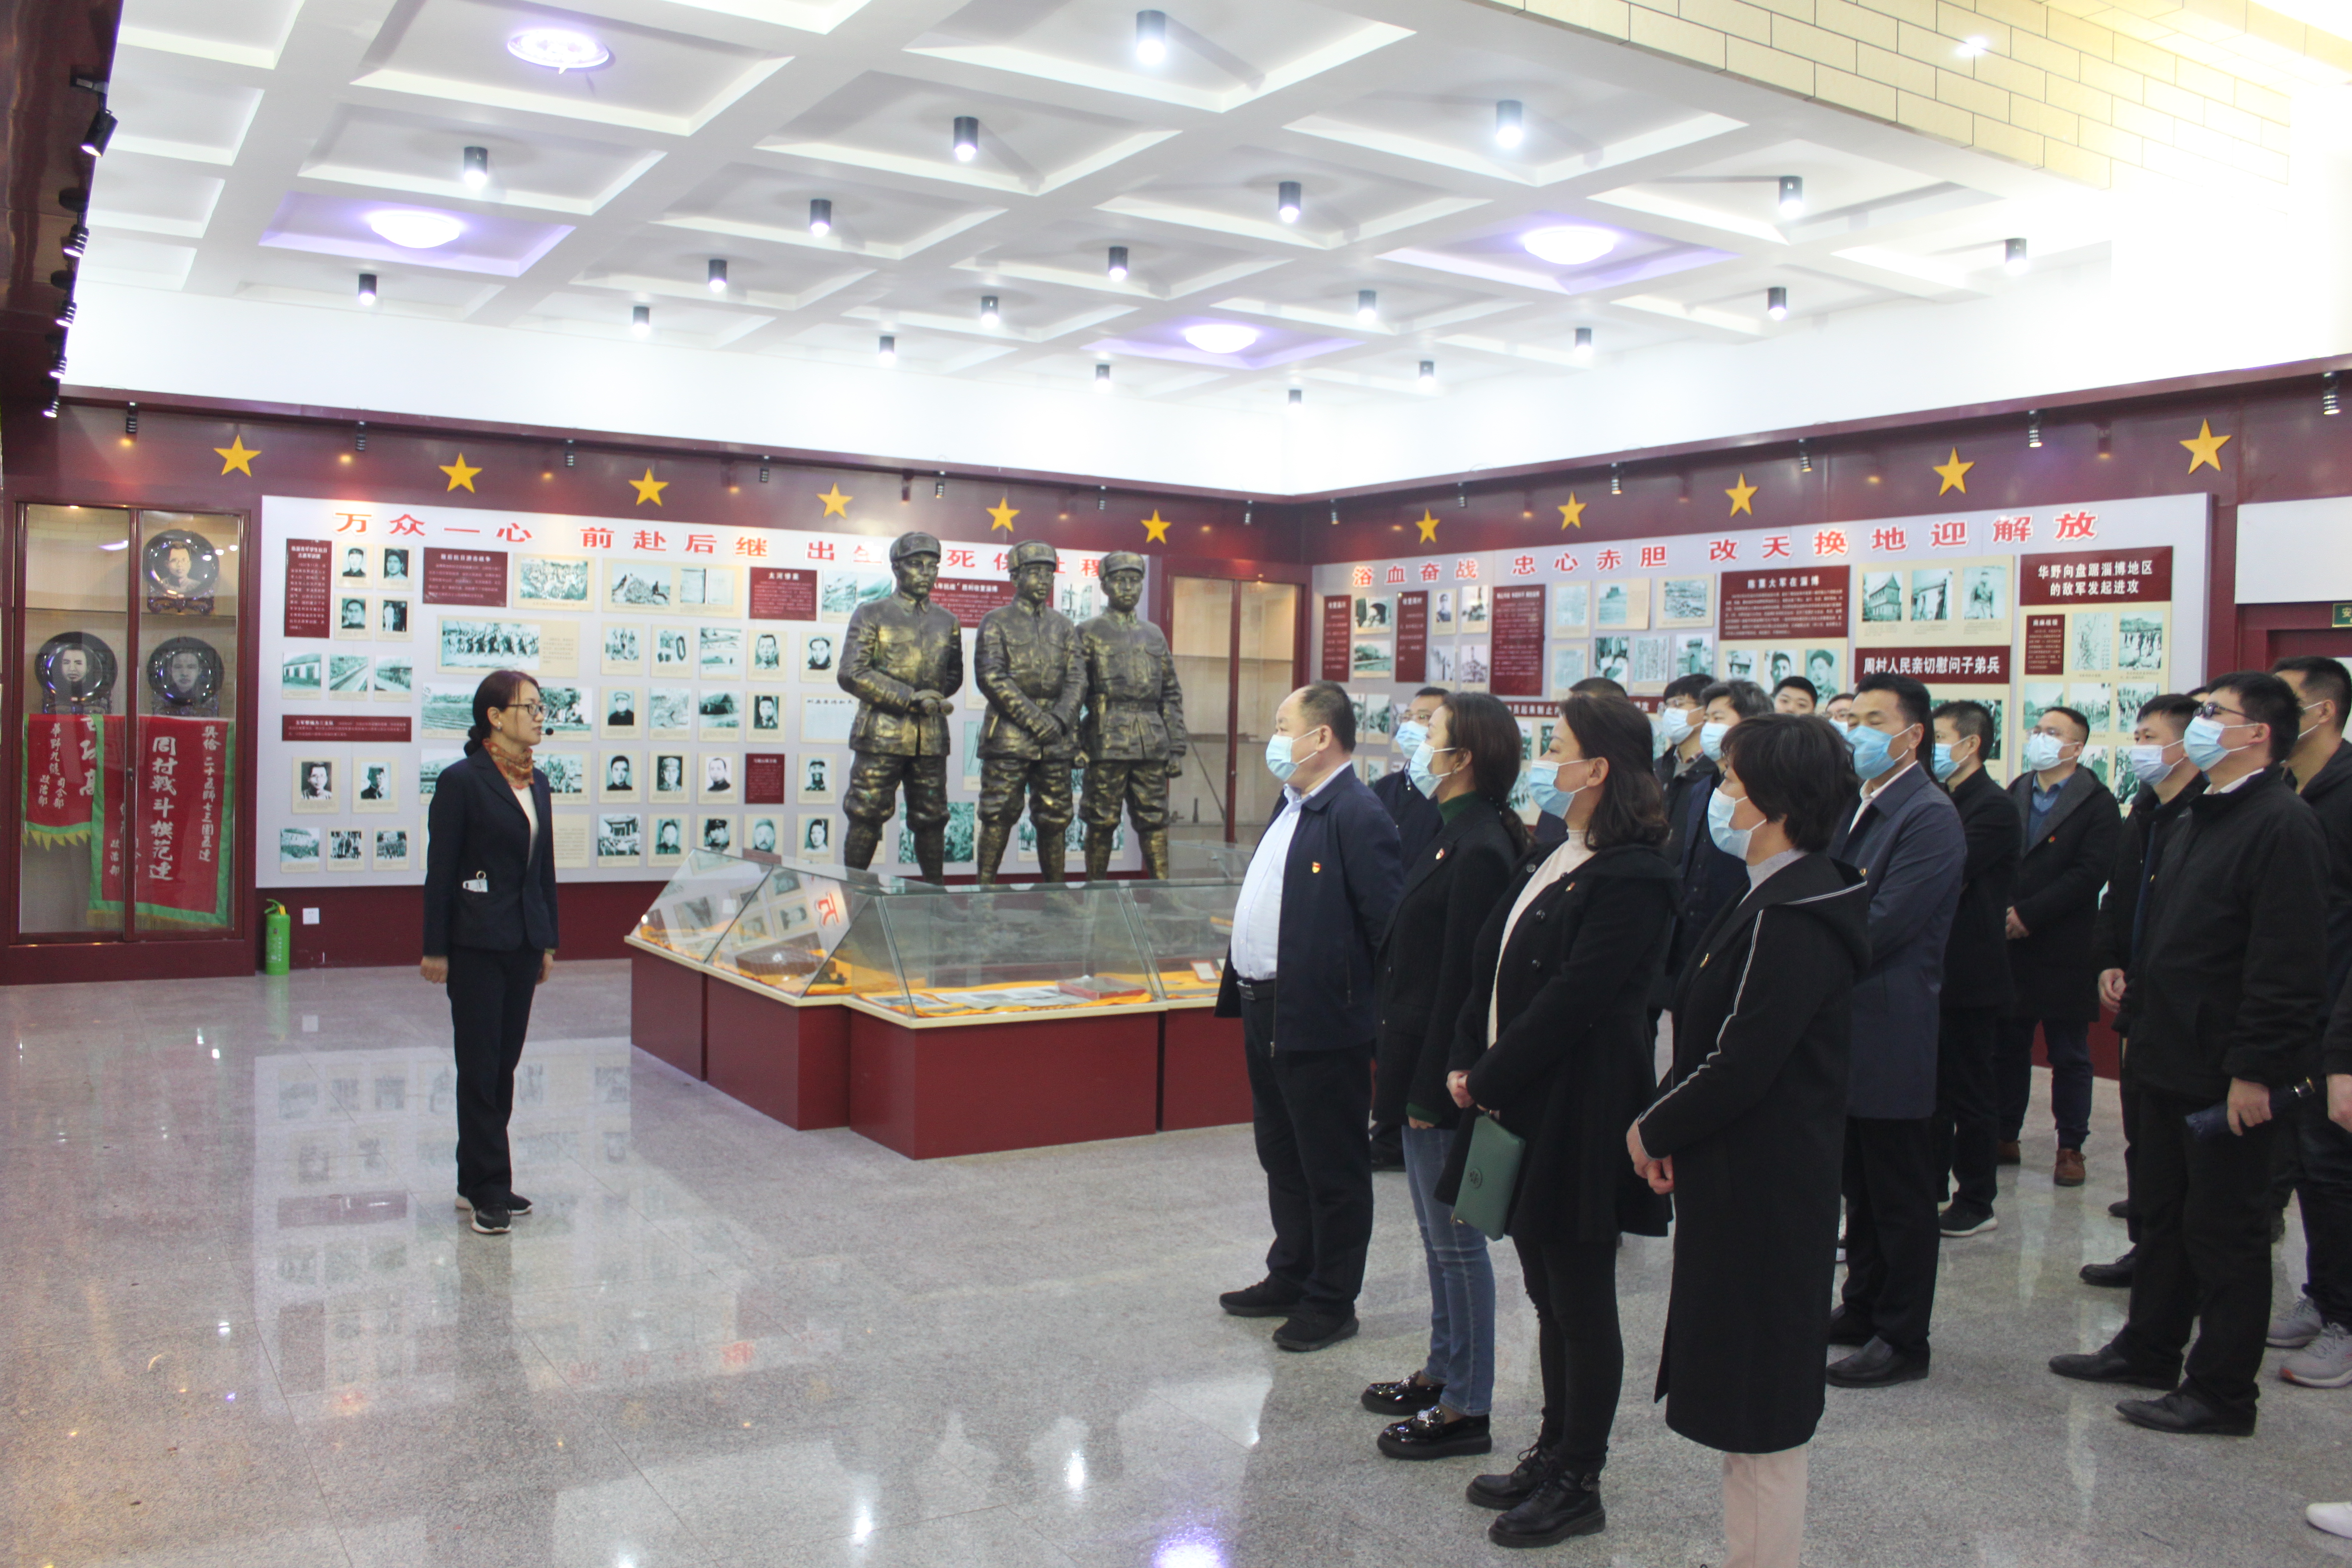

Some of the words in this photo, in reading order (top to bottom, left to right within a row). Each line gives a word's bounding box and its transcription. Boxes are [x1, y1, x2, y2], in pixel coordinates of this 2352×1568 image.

[336, 512, 532, 542] 万众一心
[580, 527, 769, 557] 前赴后继
[807, 540, 976, 568] 出生死
[1354, 559, 1477, 586] 浴血奋战
[1512, 544, 1667, 575] 忠心赤胆
[1709, 511, 2098, 561] 改天换地迎解放
[2038, 560, 2153, 580] 华野向盘踞淄博地区
[2050, 580, 2139, 597] 的敌军发起进攻
[1863, 655, 2000, 675] 周村人民亲切慰问子弟兵
